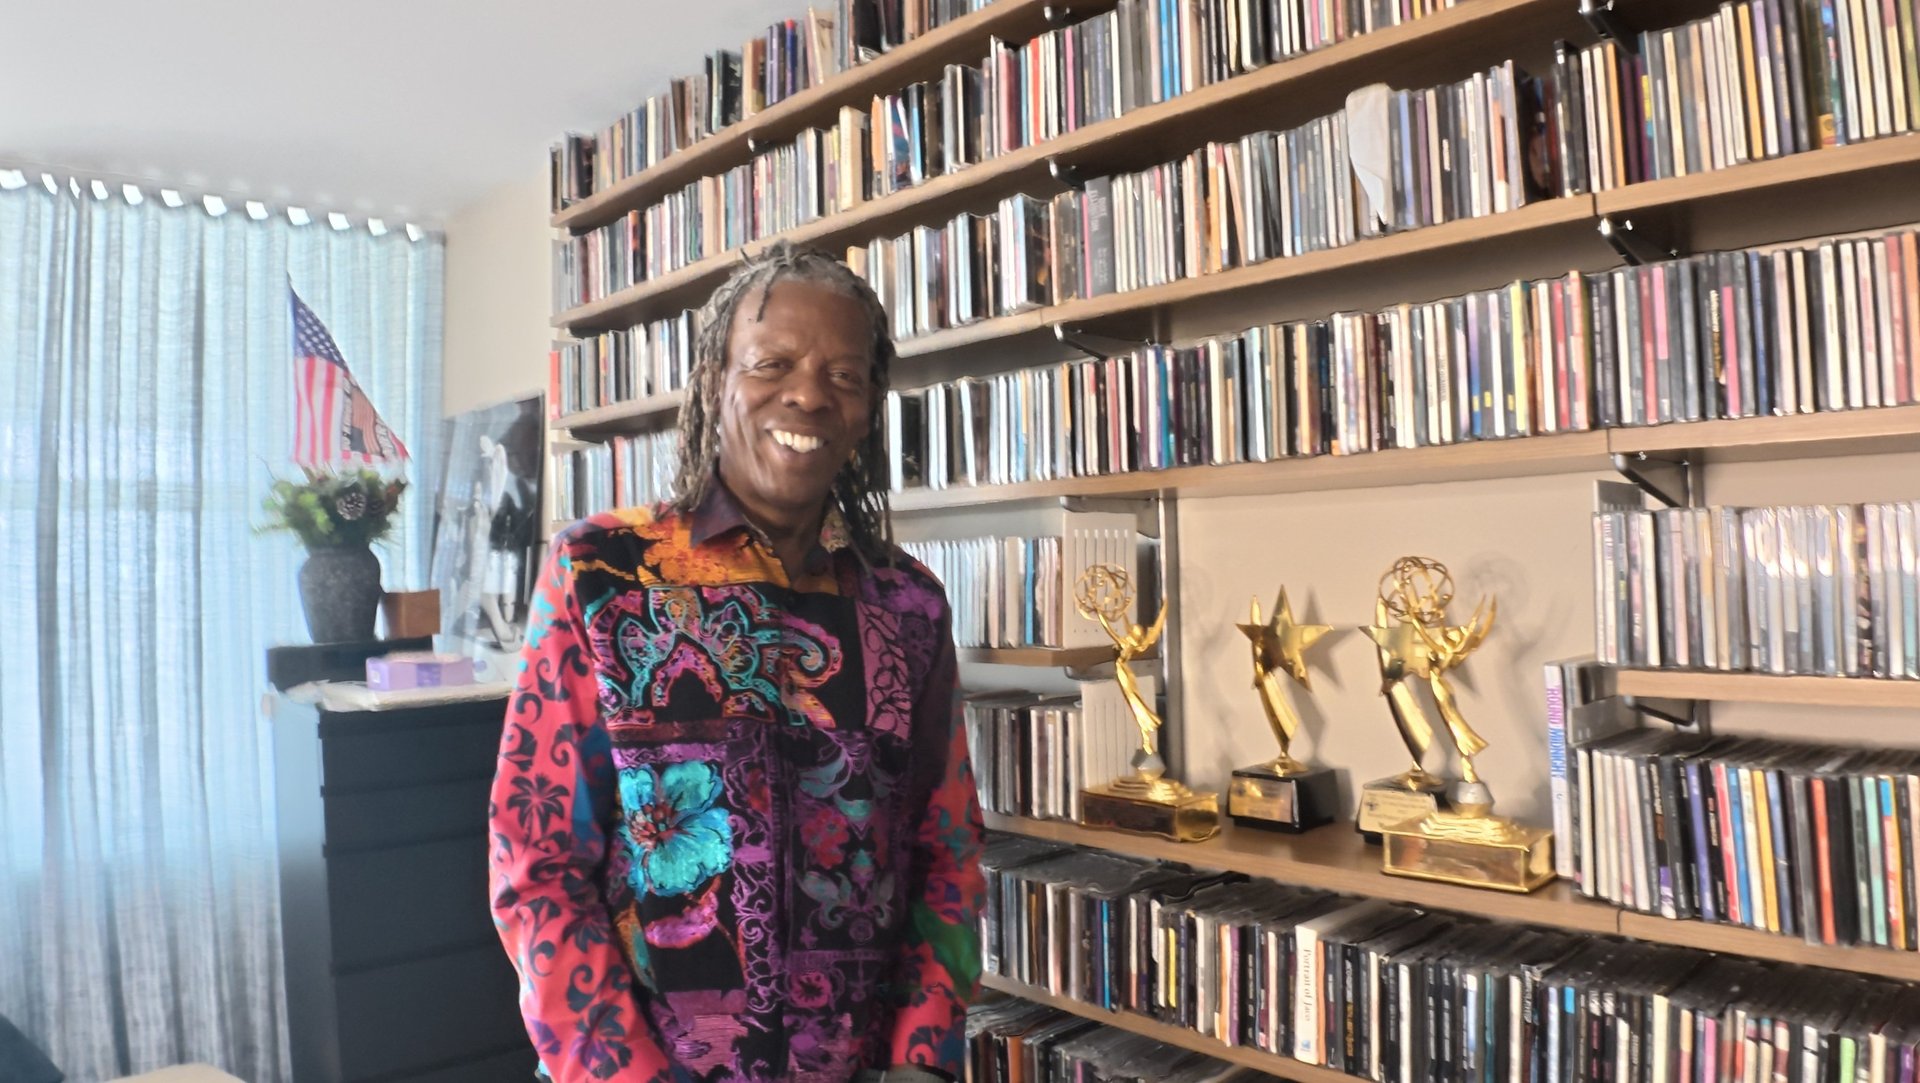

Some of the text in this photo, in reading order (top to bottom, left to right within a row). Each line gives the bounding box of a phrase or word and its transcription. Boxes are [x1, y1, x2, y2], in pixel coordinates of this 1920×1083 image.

[1548, 727, 1566, 780] MIDNIGHT
[1302, 948, 1314, 1022] Portrait of Jaco
